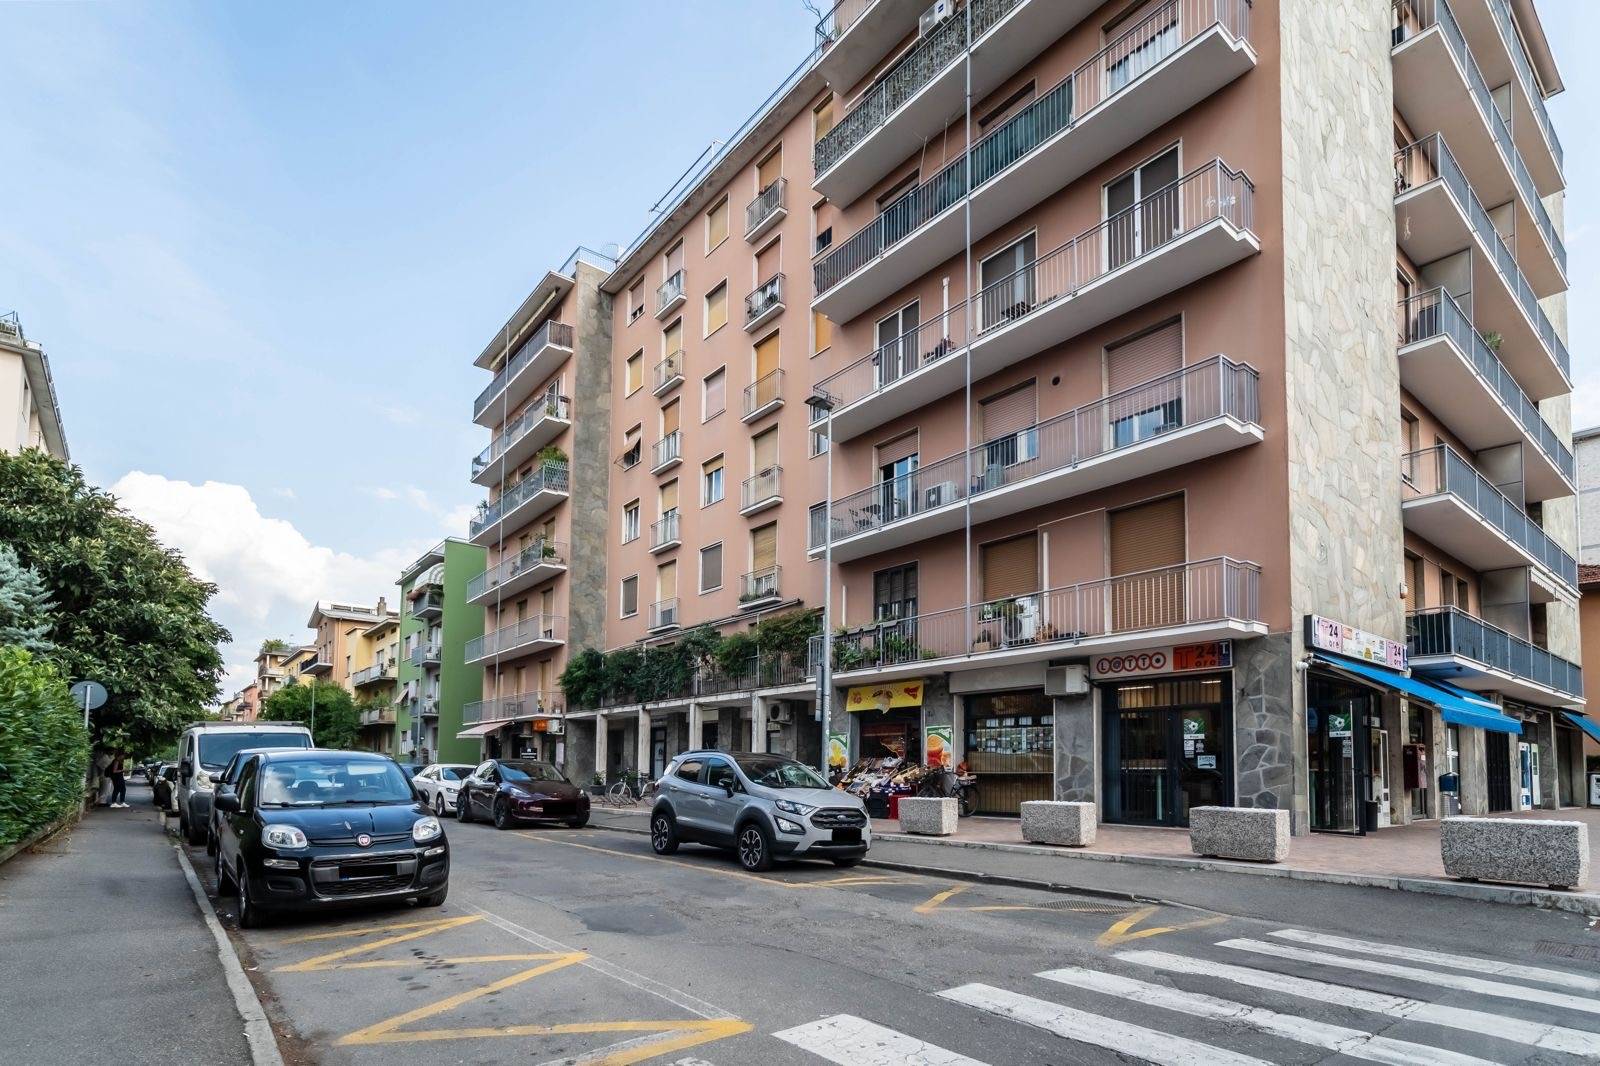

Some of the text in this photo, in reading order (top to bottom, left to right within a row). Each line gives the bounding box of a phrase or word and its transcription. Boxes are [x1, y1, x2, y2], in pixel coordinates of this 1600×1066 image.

[1328, 623, 1339, 638] 24
[1195, 643, 1217, 658] 24
[1393, 644, 1401, 657] 24
